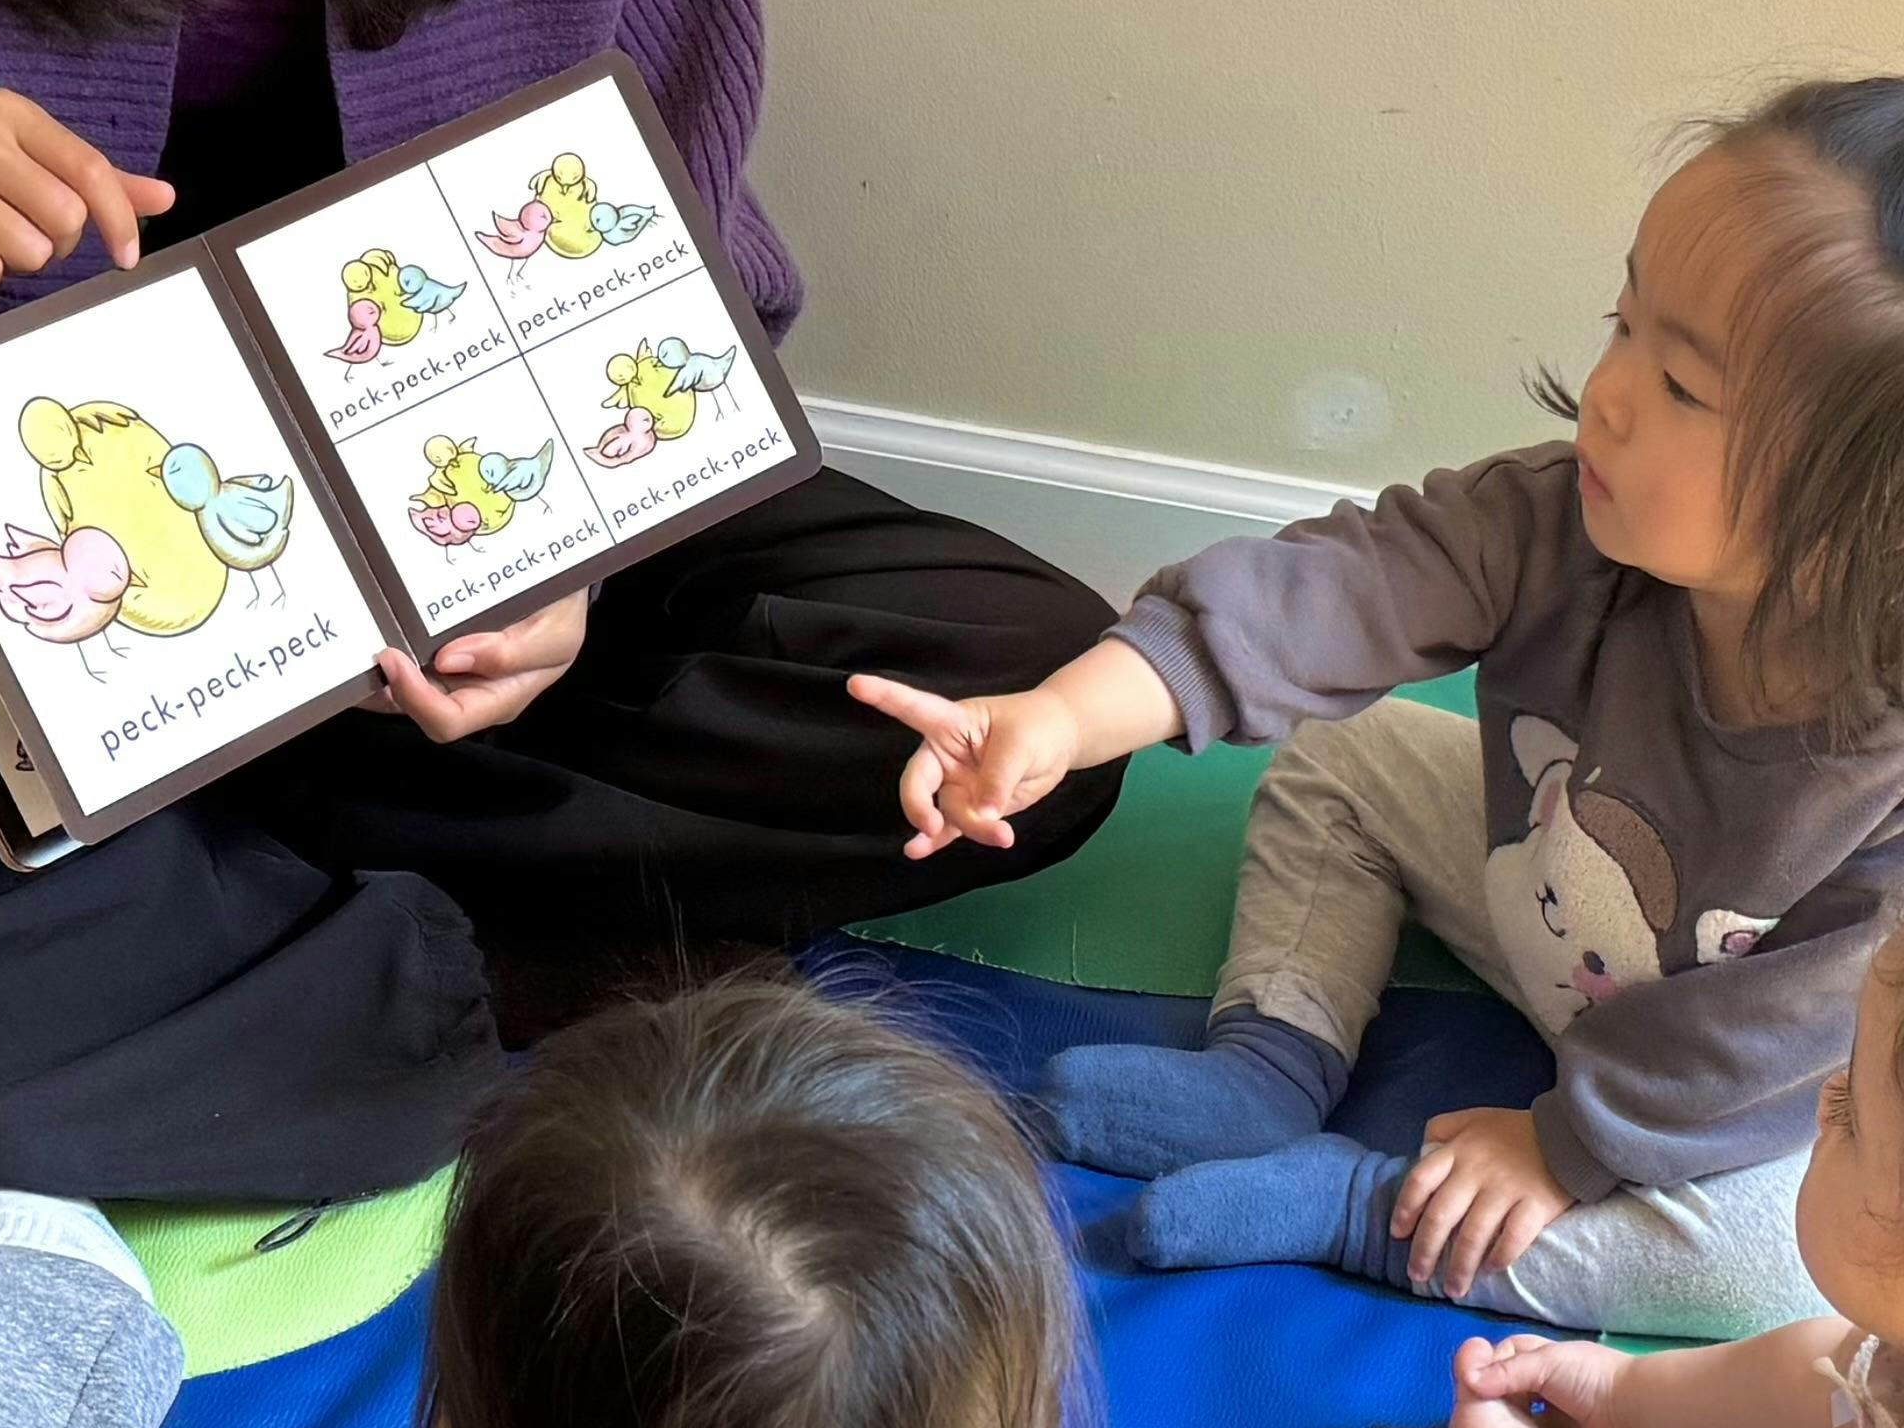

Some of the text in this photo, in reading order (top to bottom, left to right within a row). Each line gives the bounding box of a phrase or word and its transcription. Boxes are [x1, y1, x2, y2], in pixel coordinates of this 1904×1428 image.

[517, 240, 690, 340] peck-peck-peck
[329, 329, 506, 429] peck-peck-peck
[613, 428, 783, 529] peck-peck-peck
[426, 519, 600, 620] peck-peck-peck
[100, 613, 340, 761] peck-peck-peck
